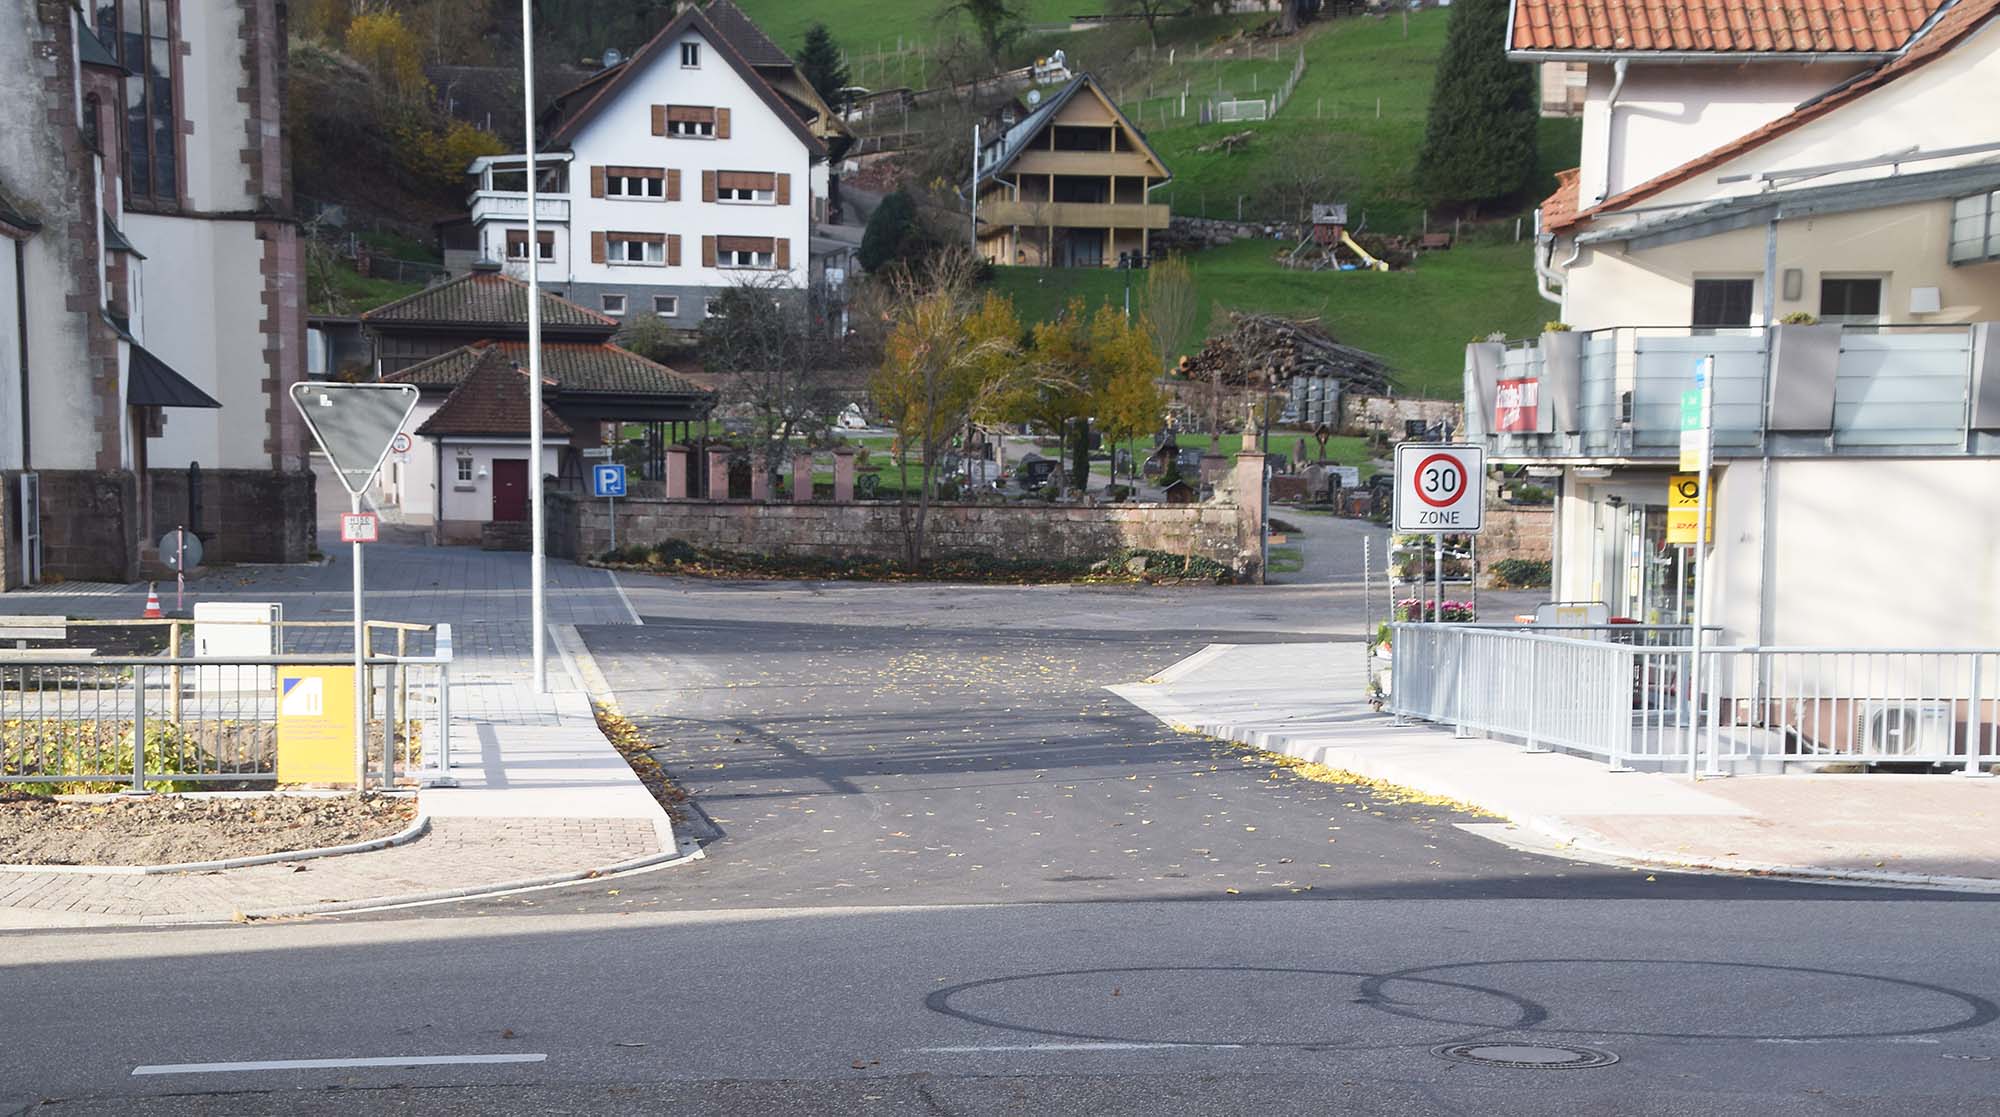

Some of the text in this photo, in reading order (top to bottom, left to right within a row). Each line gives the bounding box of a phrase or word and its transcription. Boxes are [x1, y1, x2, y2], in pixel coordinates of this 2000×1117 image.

[600, 469, 618, 494] P
[1425, 468, 1456, 492] 30
[1420, 511, 1460, 524] ZONE
